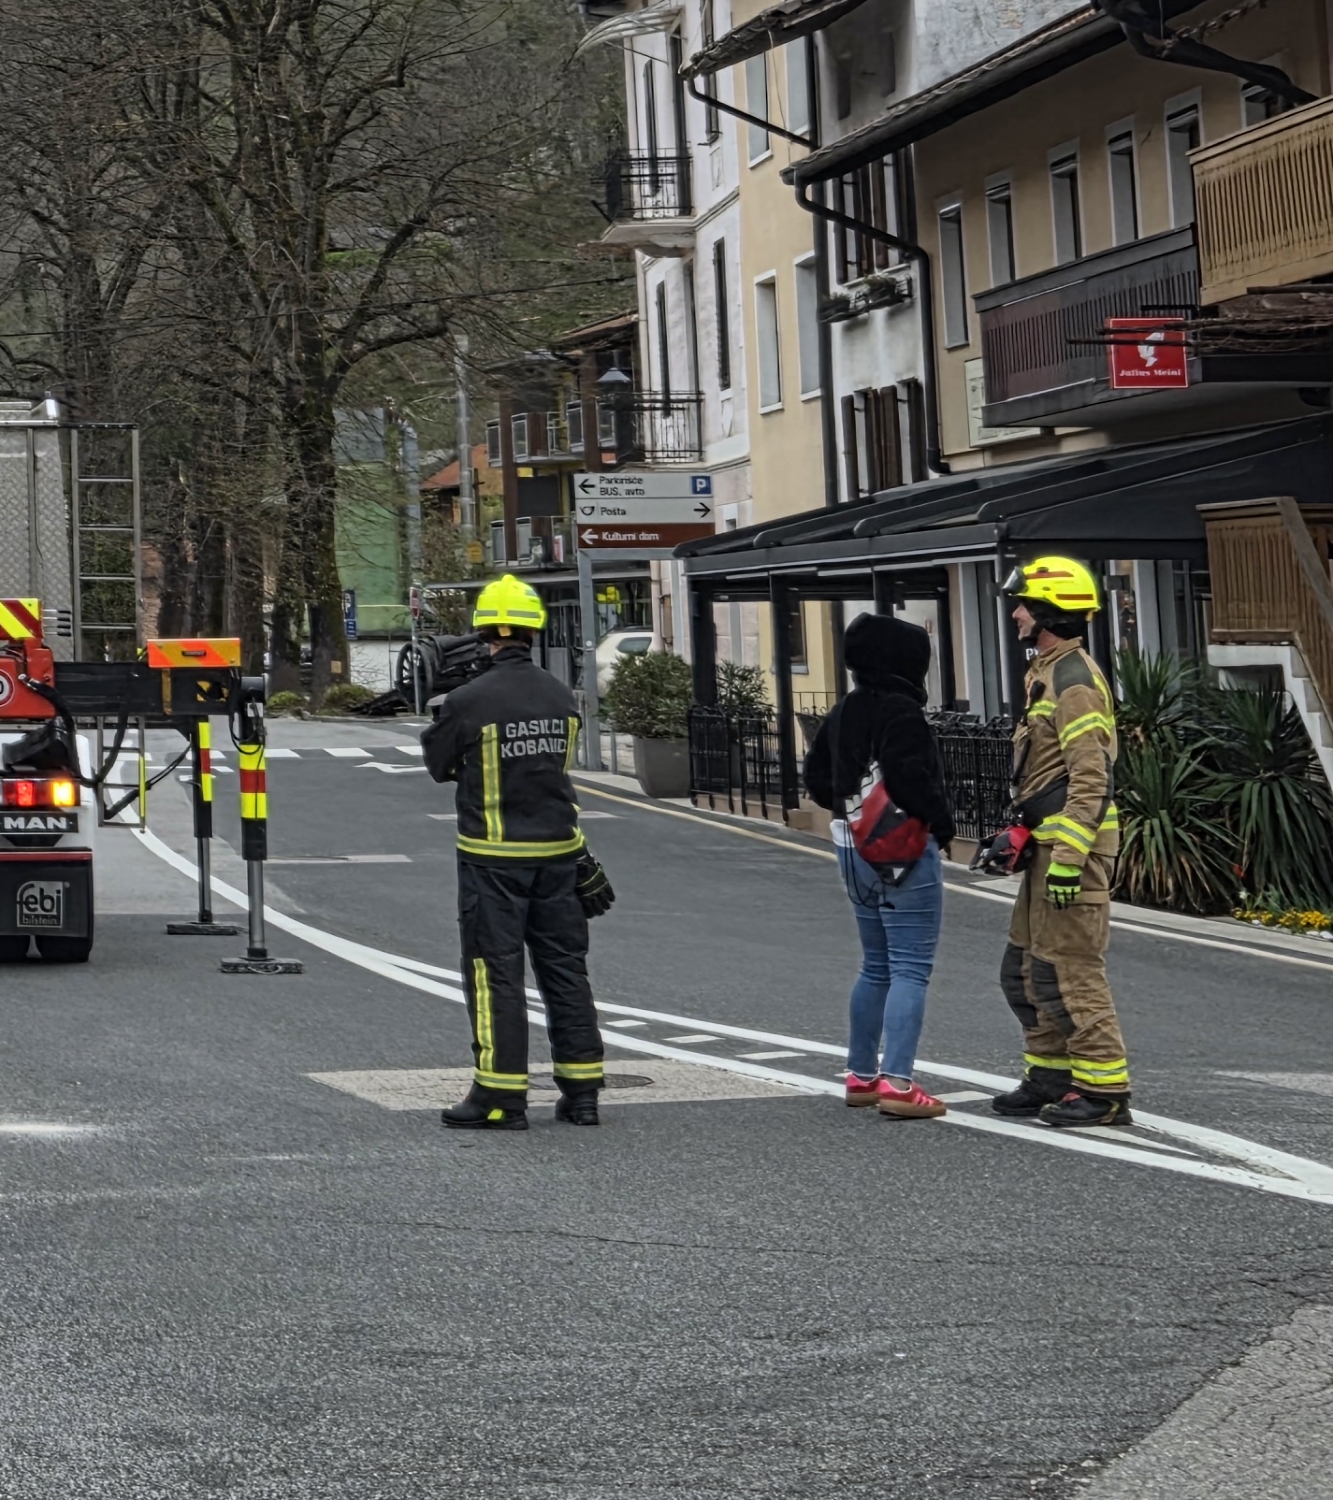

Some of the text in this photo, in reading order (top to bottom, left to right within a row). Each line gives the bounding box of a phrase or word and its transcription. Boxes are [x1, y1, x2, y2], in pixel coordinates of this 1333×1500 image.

[1119, 369, 1151, 377] Julius
[696, 478, 707, 492] P
[505, 718, 564, 738] GASILCI
[3, 816, 67, 830] MAN
